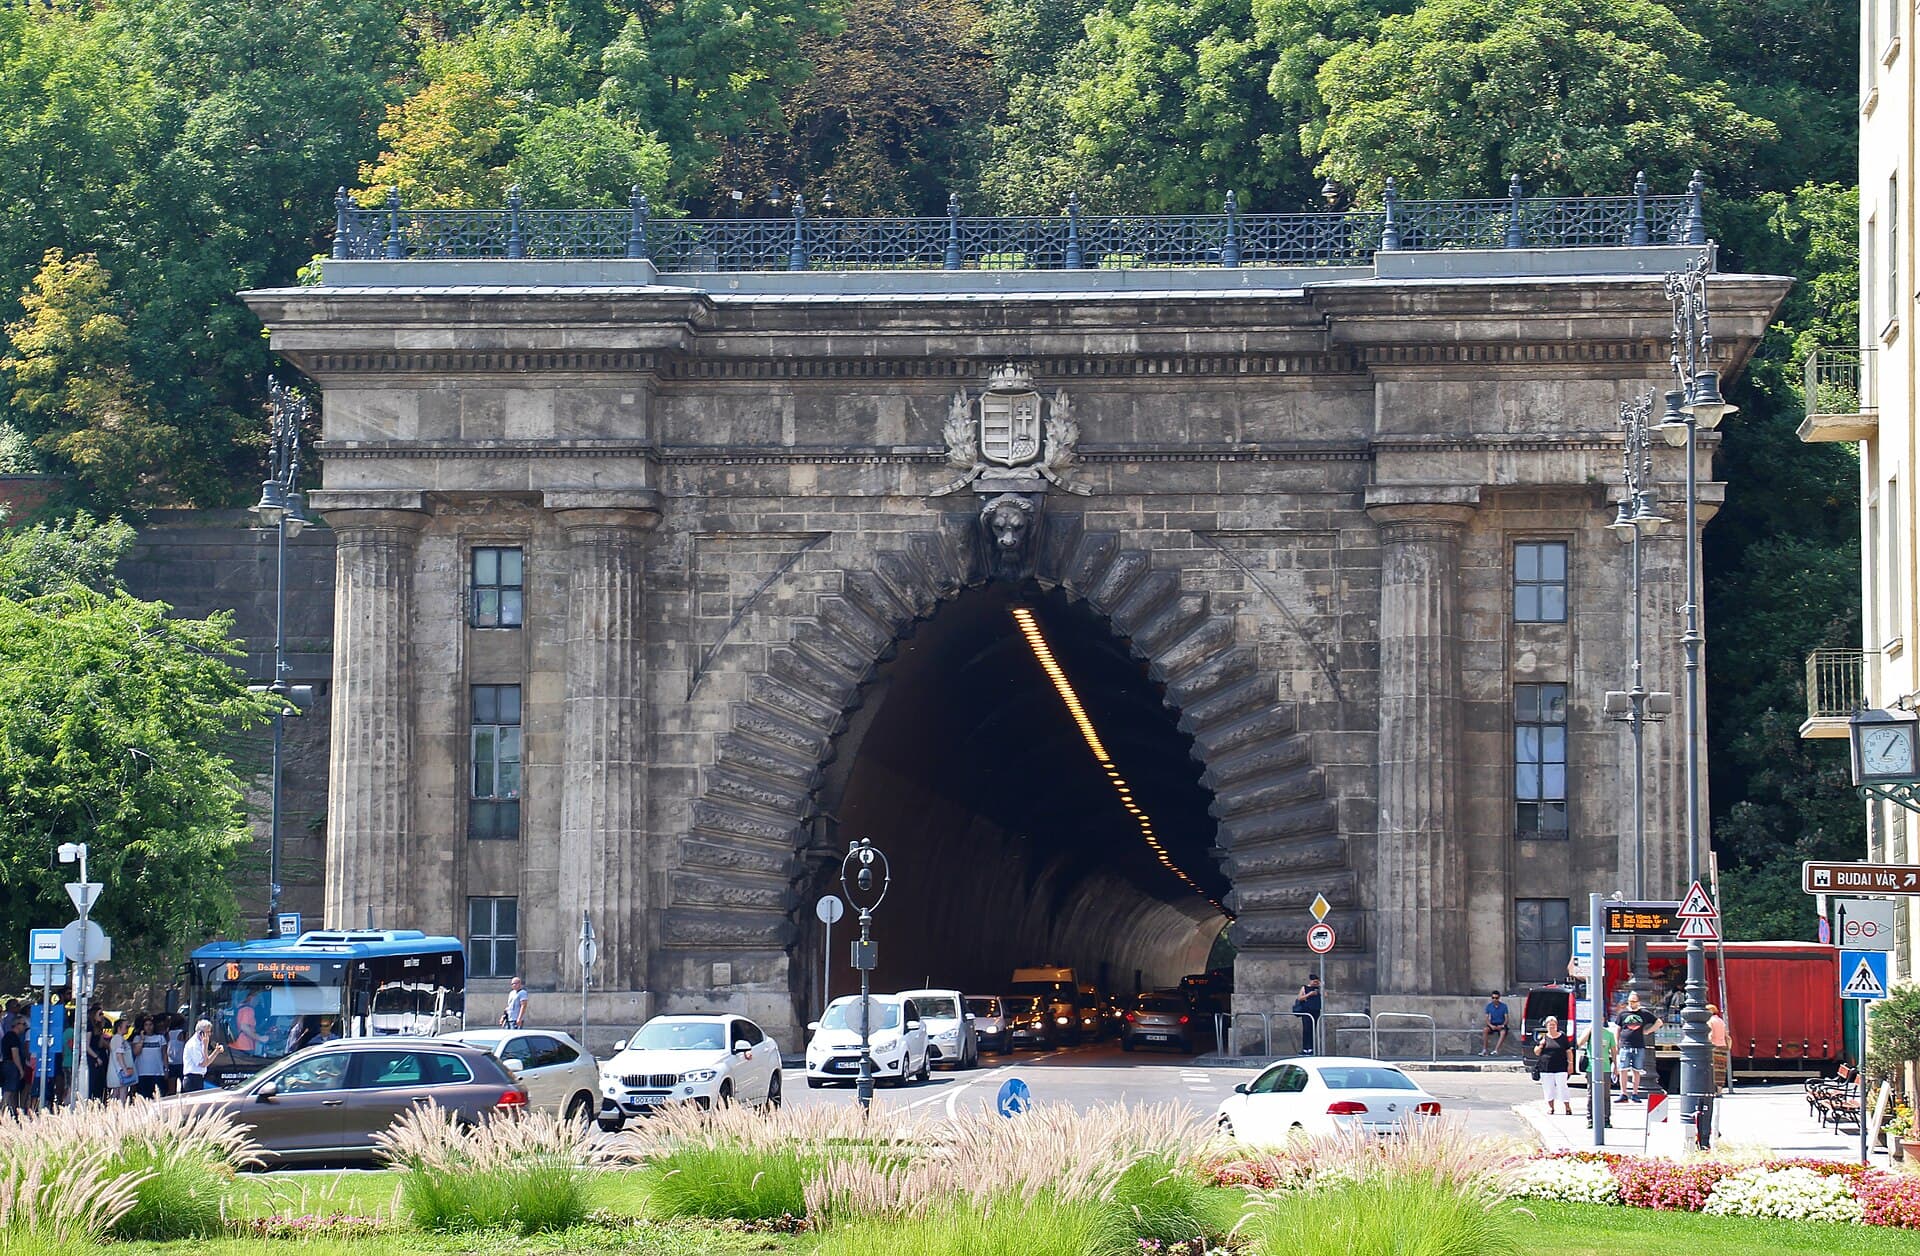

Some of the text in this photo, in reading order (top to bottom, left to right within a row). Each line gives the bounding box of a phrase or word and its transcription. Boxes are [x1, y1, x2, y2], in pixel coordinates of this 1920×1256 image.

[1837, 869, 1897, 888] BUDAI VÁR
[226, 963, 240, 980] 16
